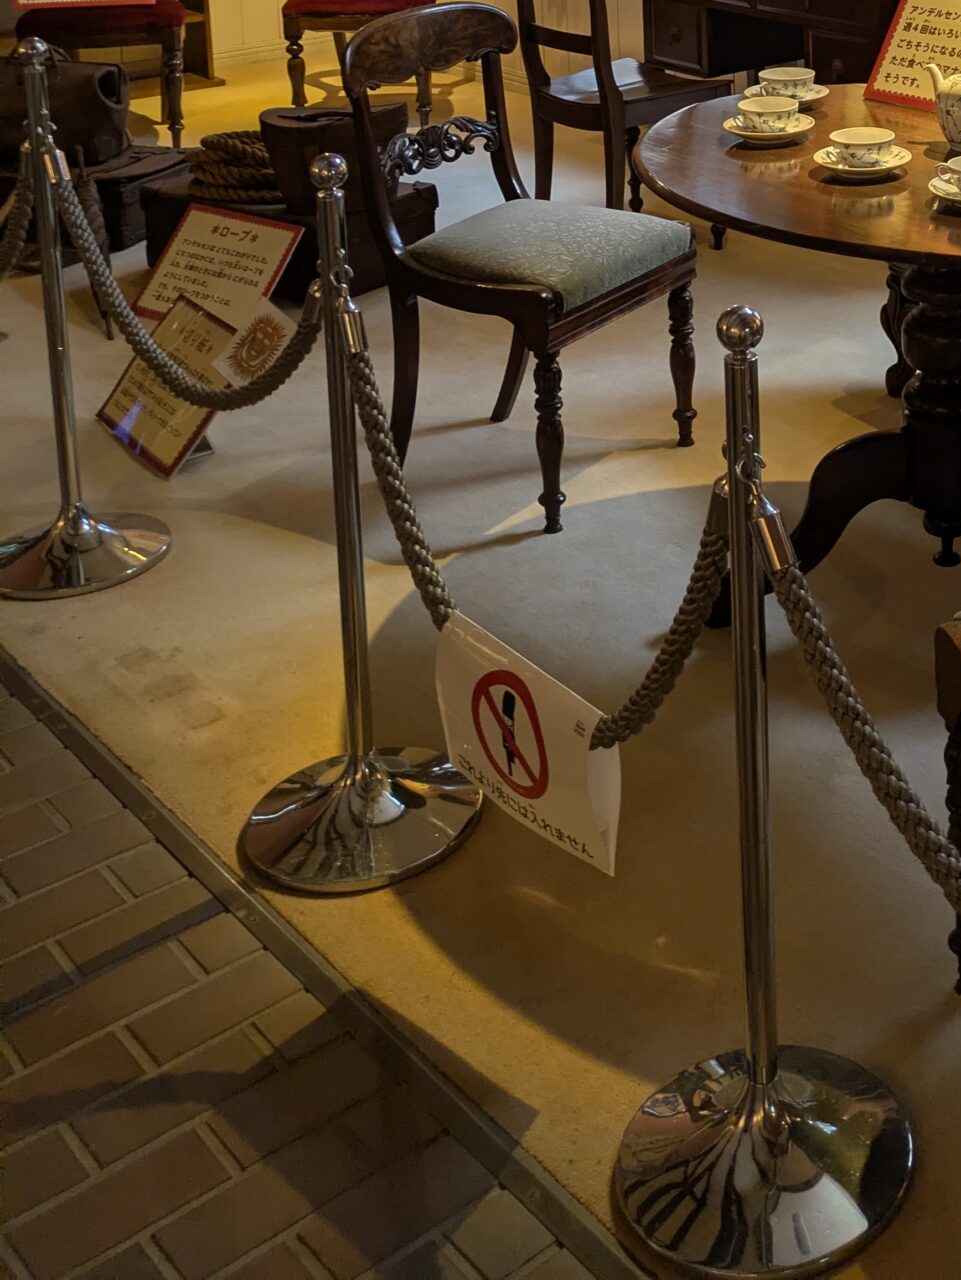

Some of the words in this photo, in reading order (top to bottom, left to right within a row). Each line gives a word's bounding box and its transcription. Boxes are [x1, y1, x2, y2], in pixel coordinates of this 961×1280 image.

[883, 72, 920, 89] そうです。
[220, 226, 252, 241] ロープ
